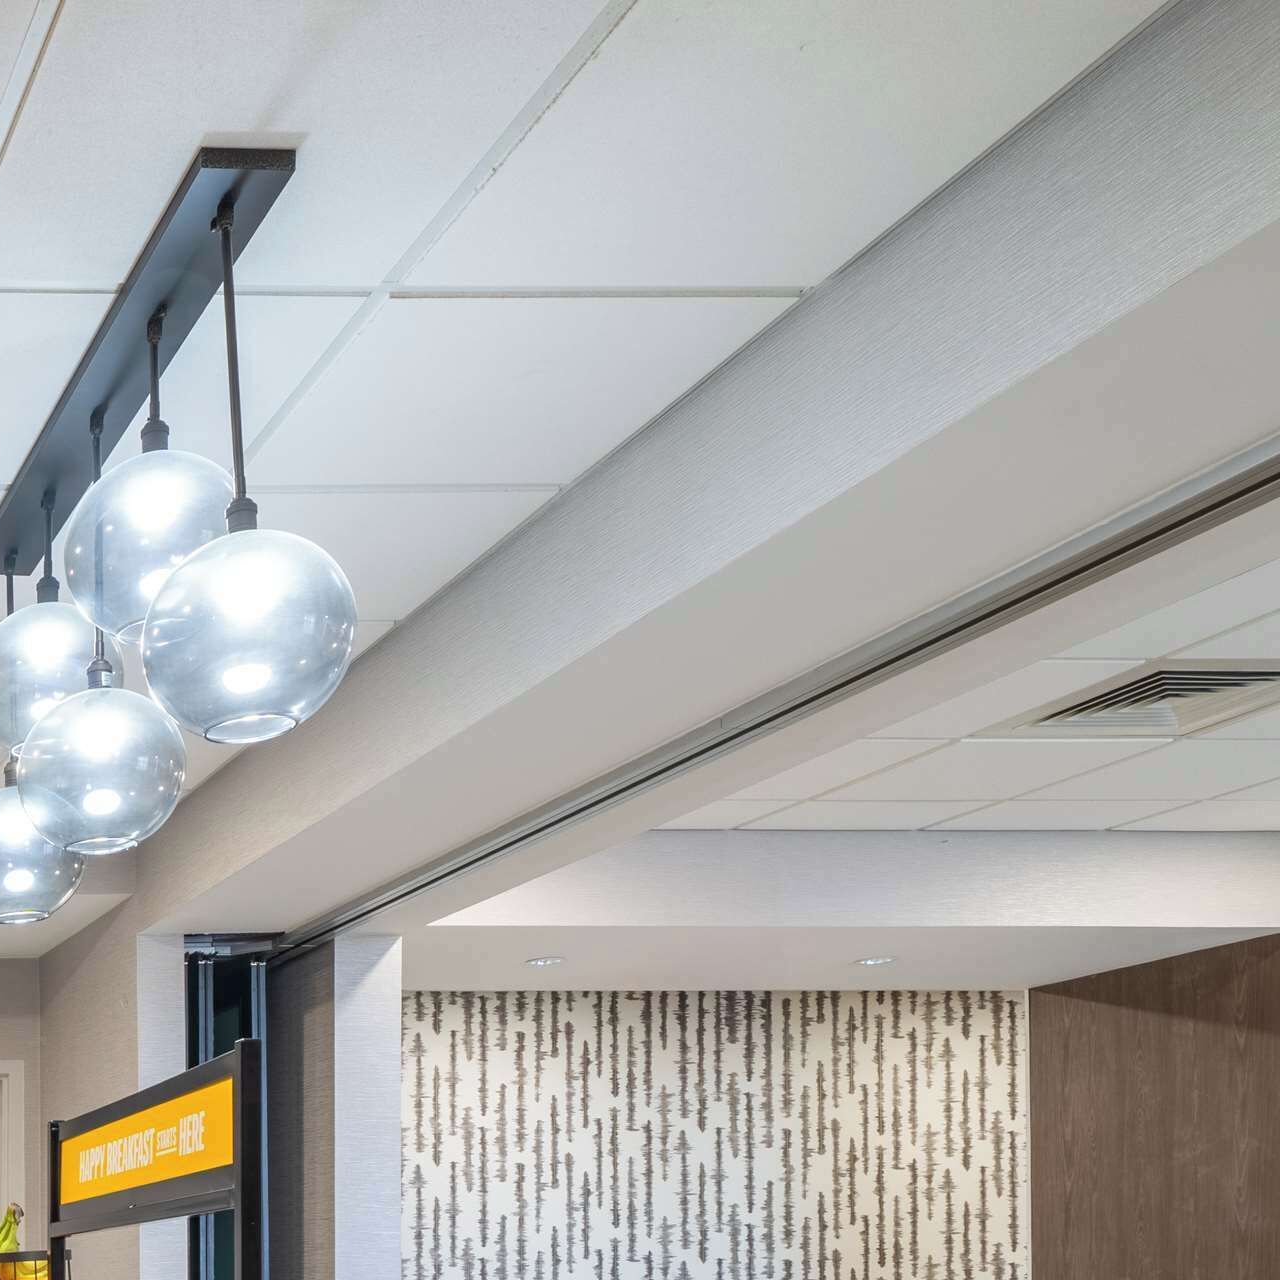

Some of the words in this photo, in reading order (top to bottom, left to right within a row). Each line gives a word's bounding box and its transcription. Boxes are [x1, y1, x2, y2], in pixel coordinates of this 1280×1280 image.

[79, 1144, 106, 1184] HAPPY
[106, 1128, 155, 1176] BREAKFAST
[156, 1126, 177, 1150] STARTS
[178, 1110, 206, 1156] HERE
